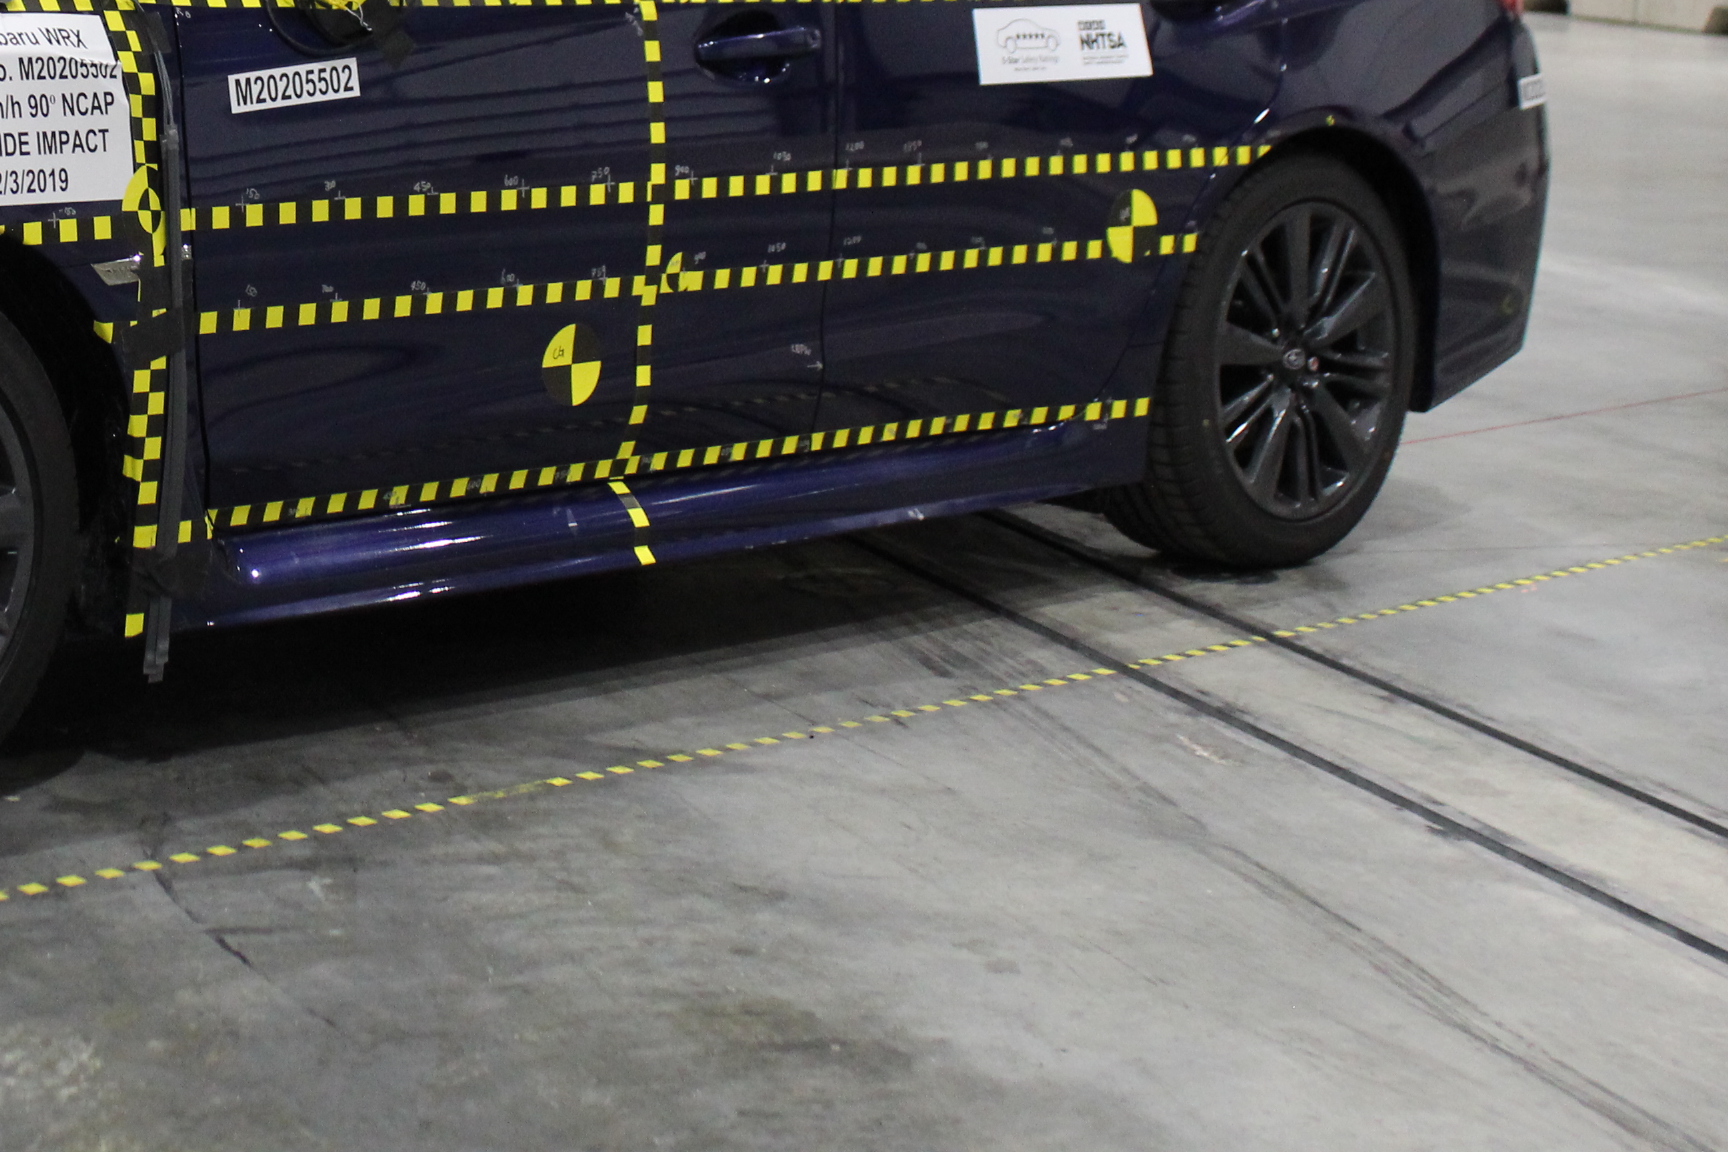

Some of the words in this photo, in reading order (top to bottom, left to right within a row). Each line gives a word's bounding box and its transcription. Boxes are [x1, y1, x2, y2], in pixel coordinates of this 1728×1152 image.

[39, 26, 89, 50] WRX
[1079, 32, 1128, 50] NHTSA
[18, 55, 119, 82] M20205502
[234, 64, 355, 107] M20205502
[60, 91, 115, 117] NCAP
[35, 128, 110, 156] IMPACT
